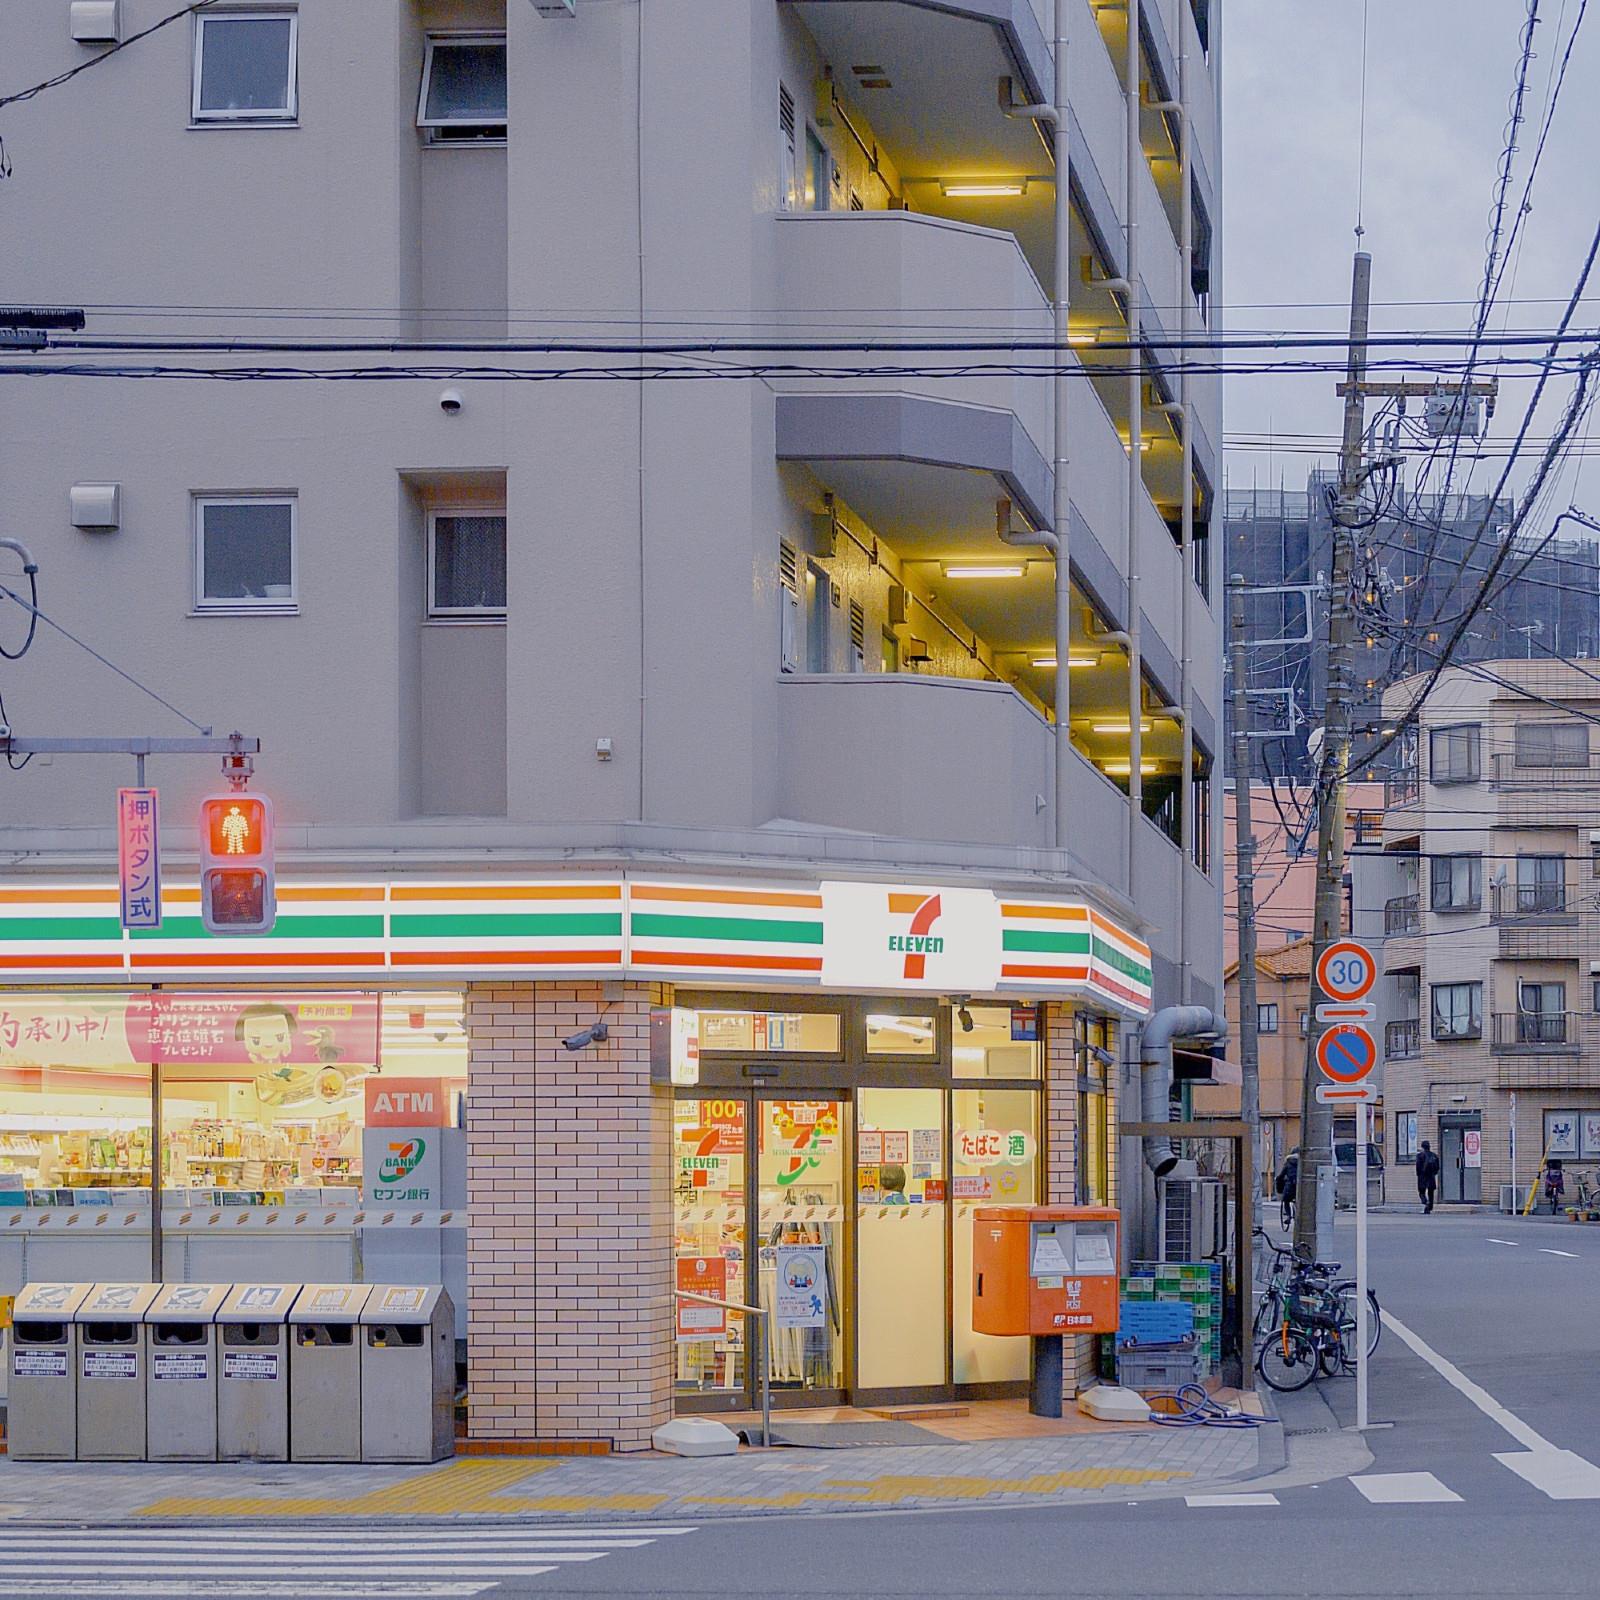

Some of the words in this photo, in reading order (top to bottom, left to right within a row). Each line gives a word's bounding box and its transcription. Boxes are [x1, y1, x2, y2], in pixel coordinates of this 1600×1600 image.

[128, 799, 152, 918] 押ボタン式
[1332, 960, 1362, 984] 30
[373, 1092, 434, 1113] ATM
[962, 1134, 1001, 1157] たばこ
[1008, 1135, 1025, 1156] 酒
[385, 1157, 416, 1167] BANK
[374, 1188, 430, 1201] セブン銀行
